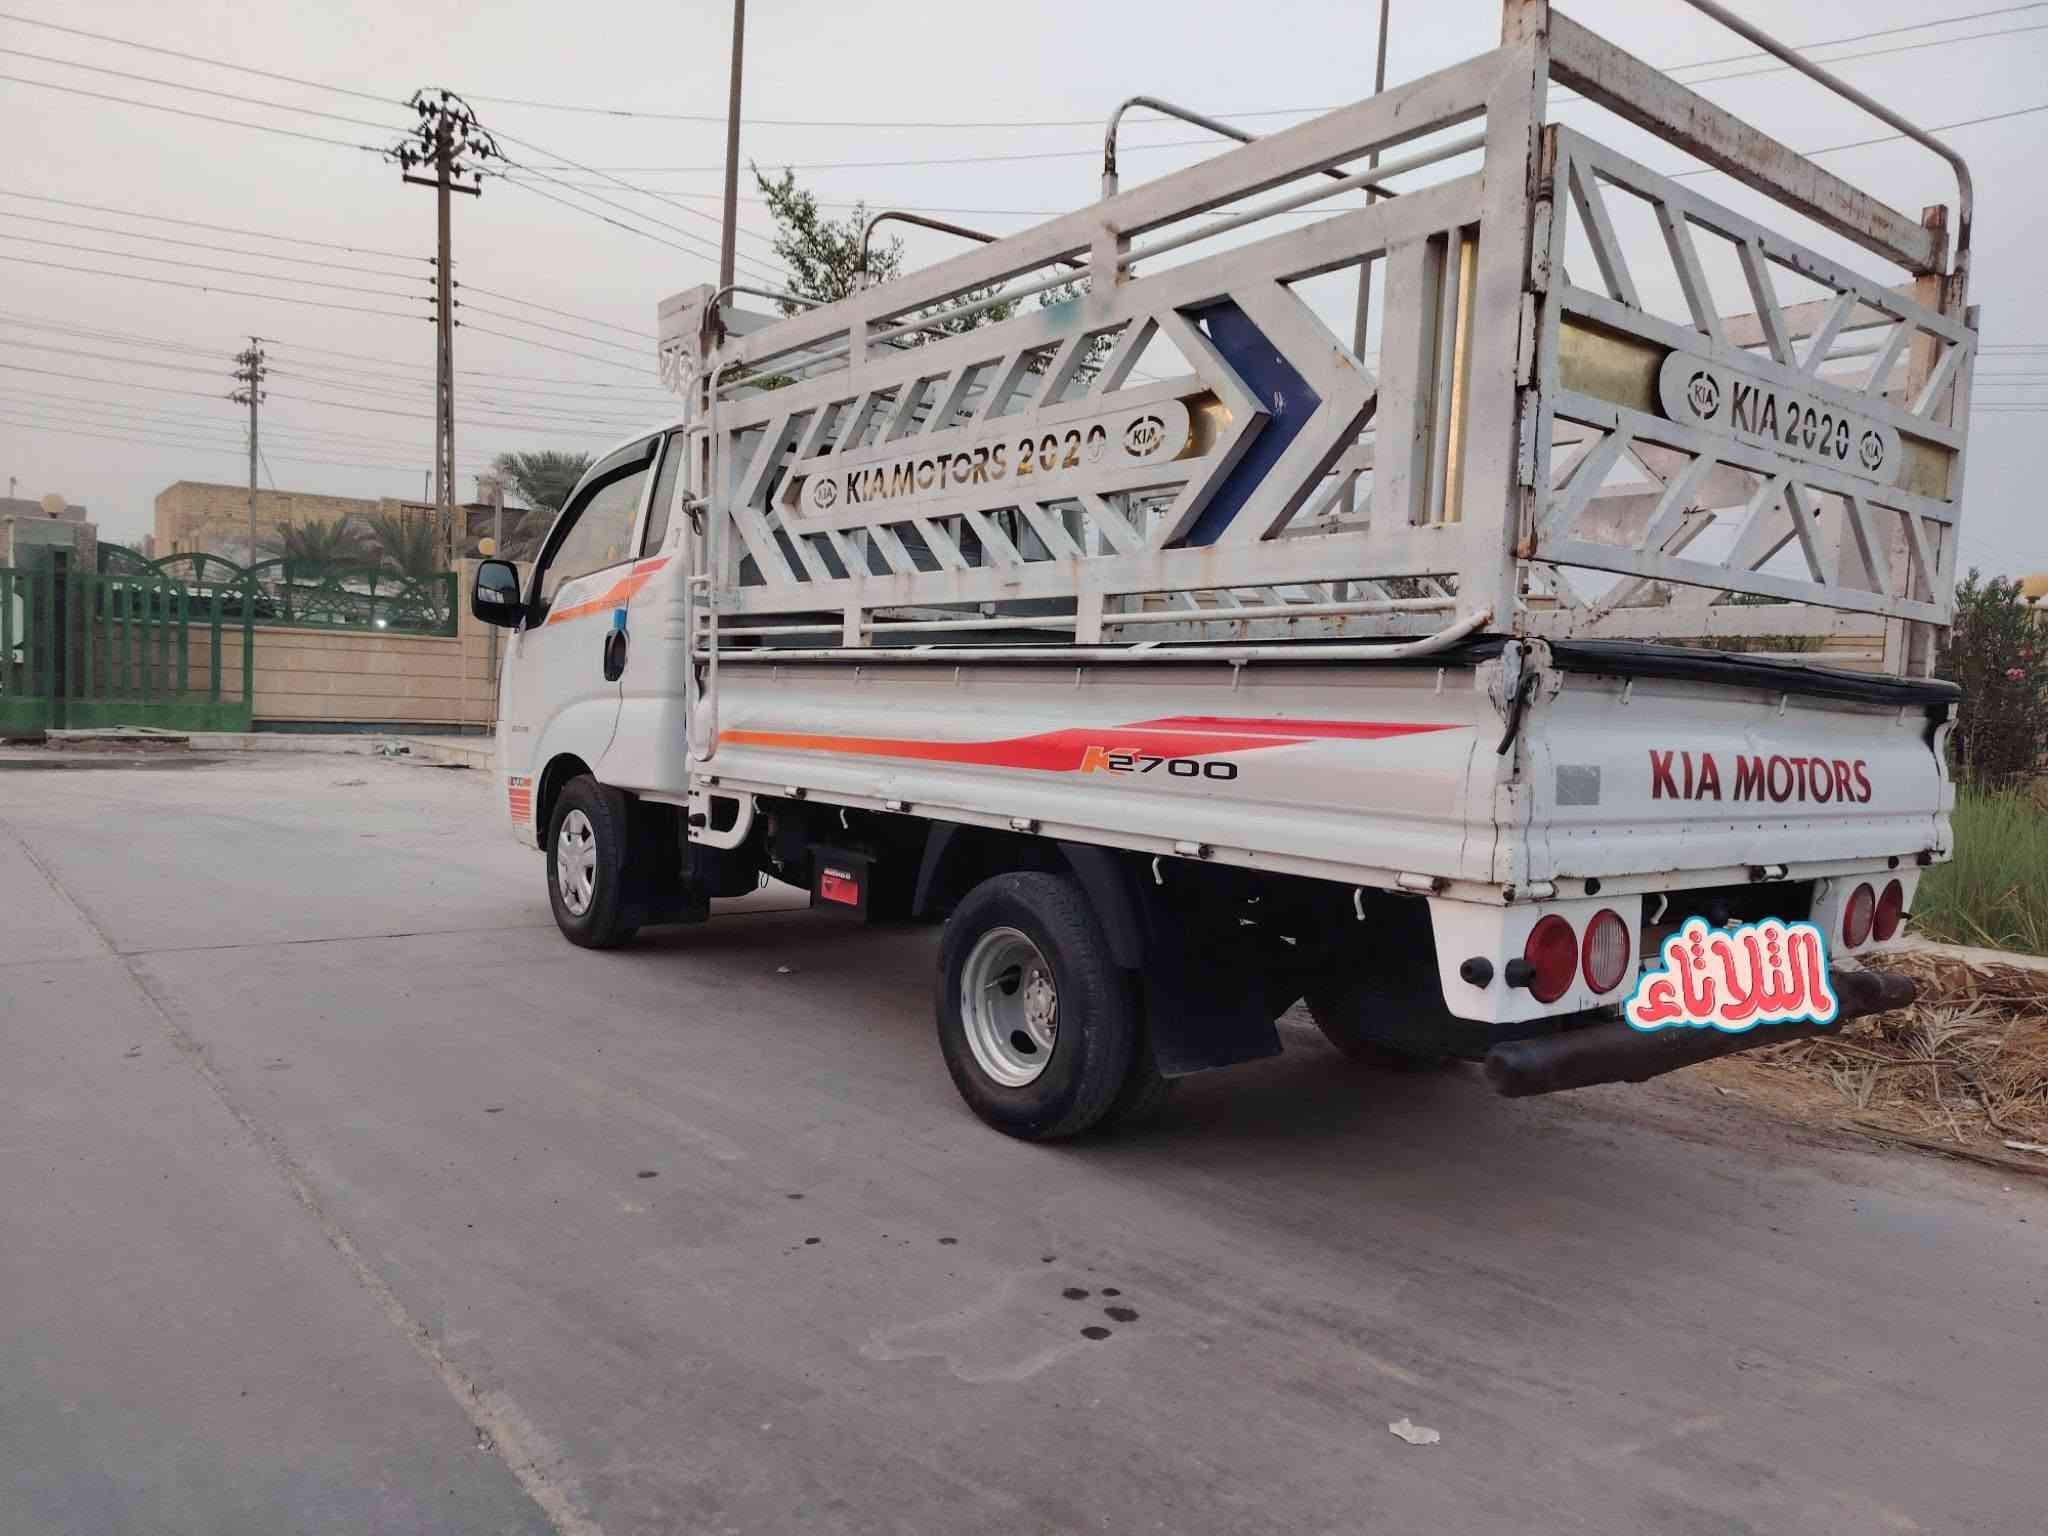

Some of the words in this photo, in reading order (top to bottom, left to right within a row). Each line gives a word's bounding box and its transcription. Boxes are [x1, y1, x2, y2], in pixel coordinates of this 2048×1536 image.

[1730, 381, 1779, 440] KIA
[1785, 401, 1849, 460] 2020
[1016, 424, 1107, 477] 2020
[1649, 749, 1721, 800] KIA
[1733, 754, 1872, 803] MOTORS
